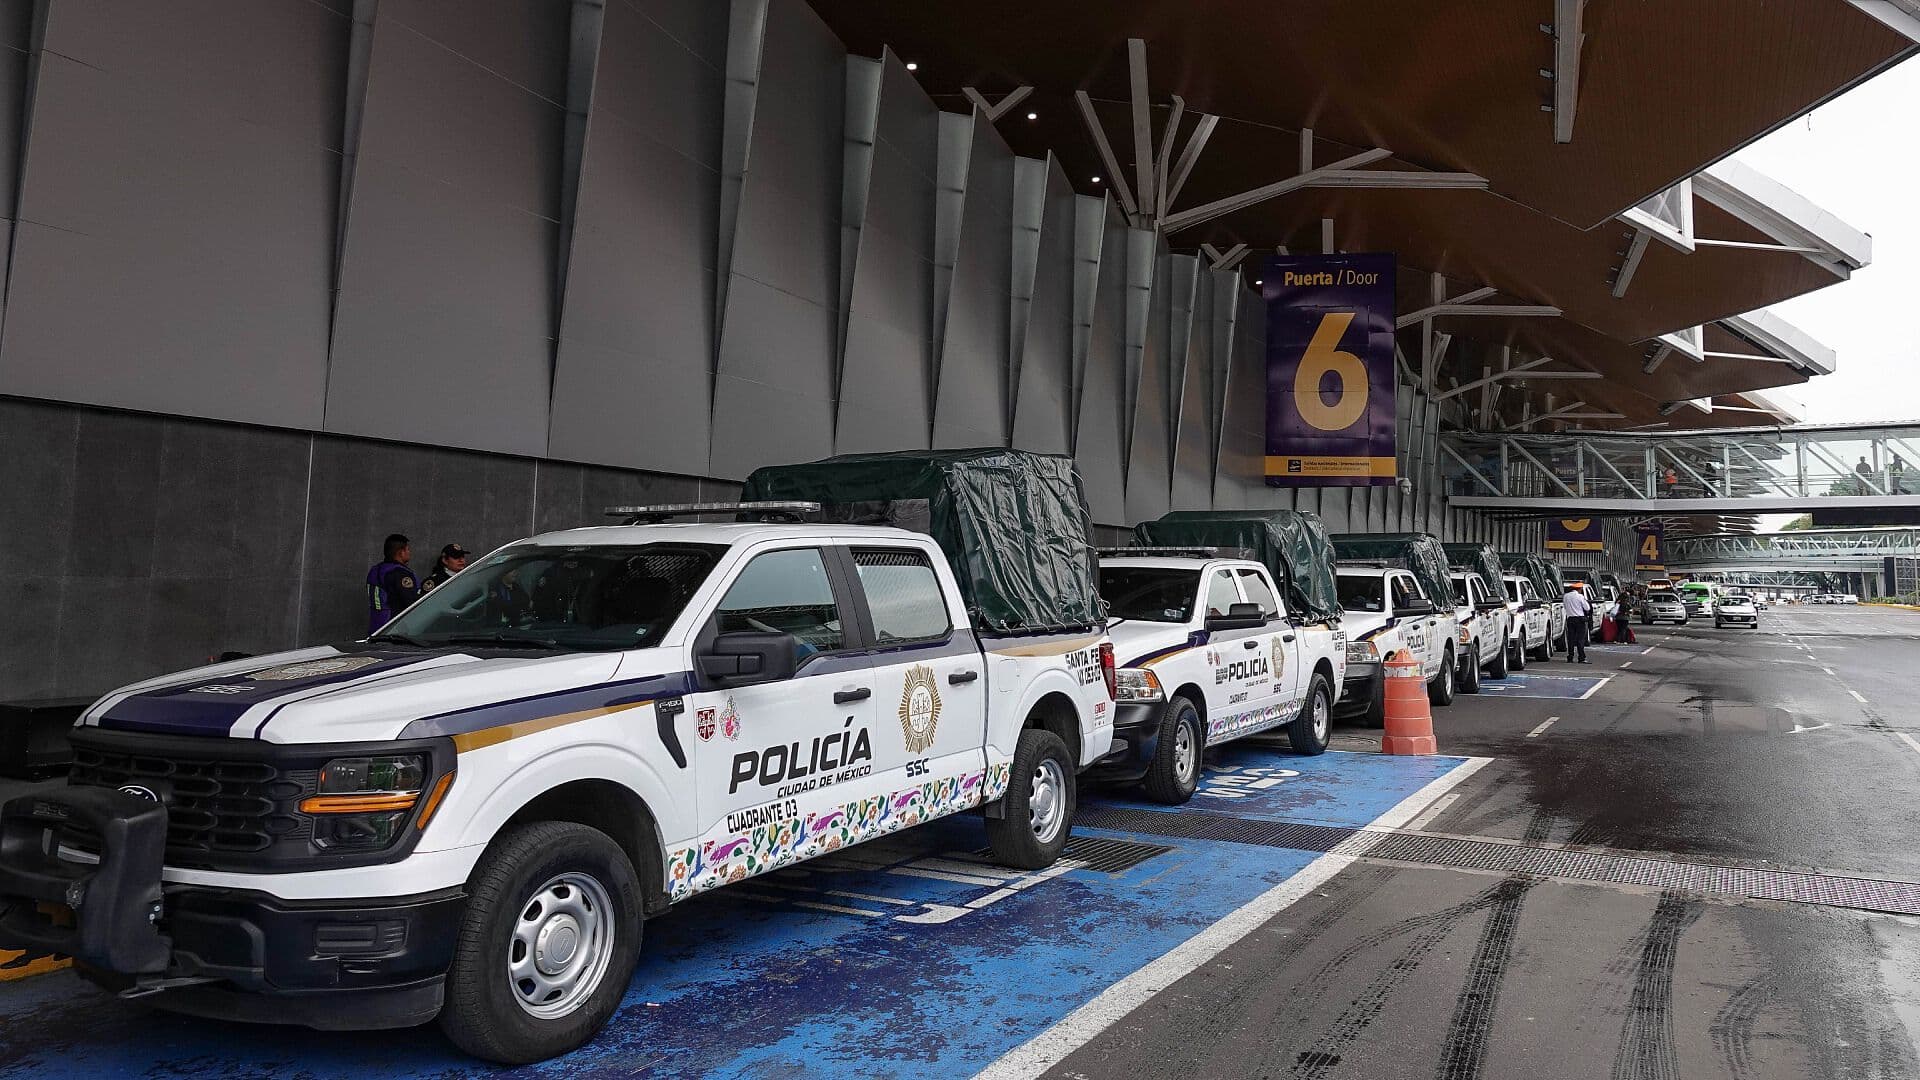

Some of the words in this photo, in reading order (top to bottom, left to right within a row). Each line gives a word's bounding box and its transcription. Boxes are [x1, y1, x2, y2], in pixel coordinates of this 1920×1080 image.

[1284, 271, 1333, 286] Puerta
[1337, 269, 1343, 285] /
[1347, 270, 1379, 285] Door
[1294, 312, 1369, 431] 6
[1641, 534, 1659, 560] 4
[1065, 650, 1089, 669] SANTA
[1090, 648, 1100, 664] FE
[1228, 651, 1269, 682] POLICÍA
[728, 715, 872, 795] POLICÍA
[905, 758, 930, 778] SSC
[777, 779, 816, 798] CIUDAD
[819, 774, 832, 788] DE
[835, 763, 872, 783] MÉXICO
[727, 802, 783, 834] CUADRANTE
[786, 798, 798, 818] 03
